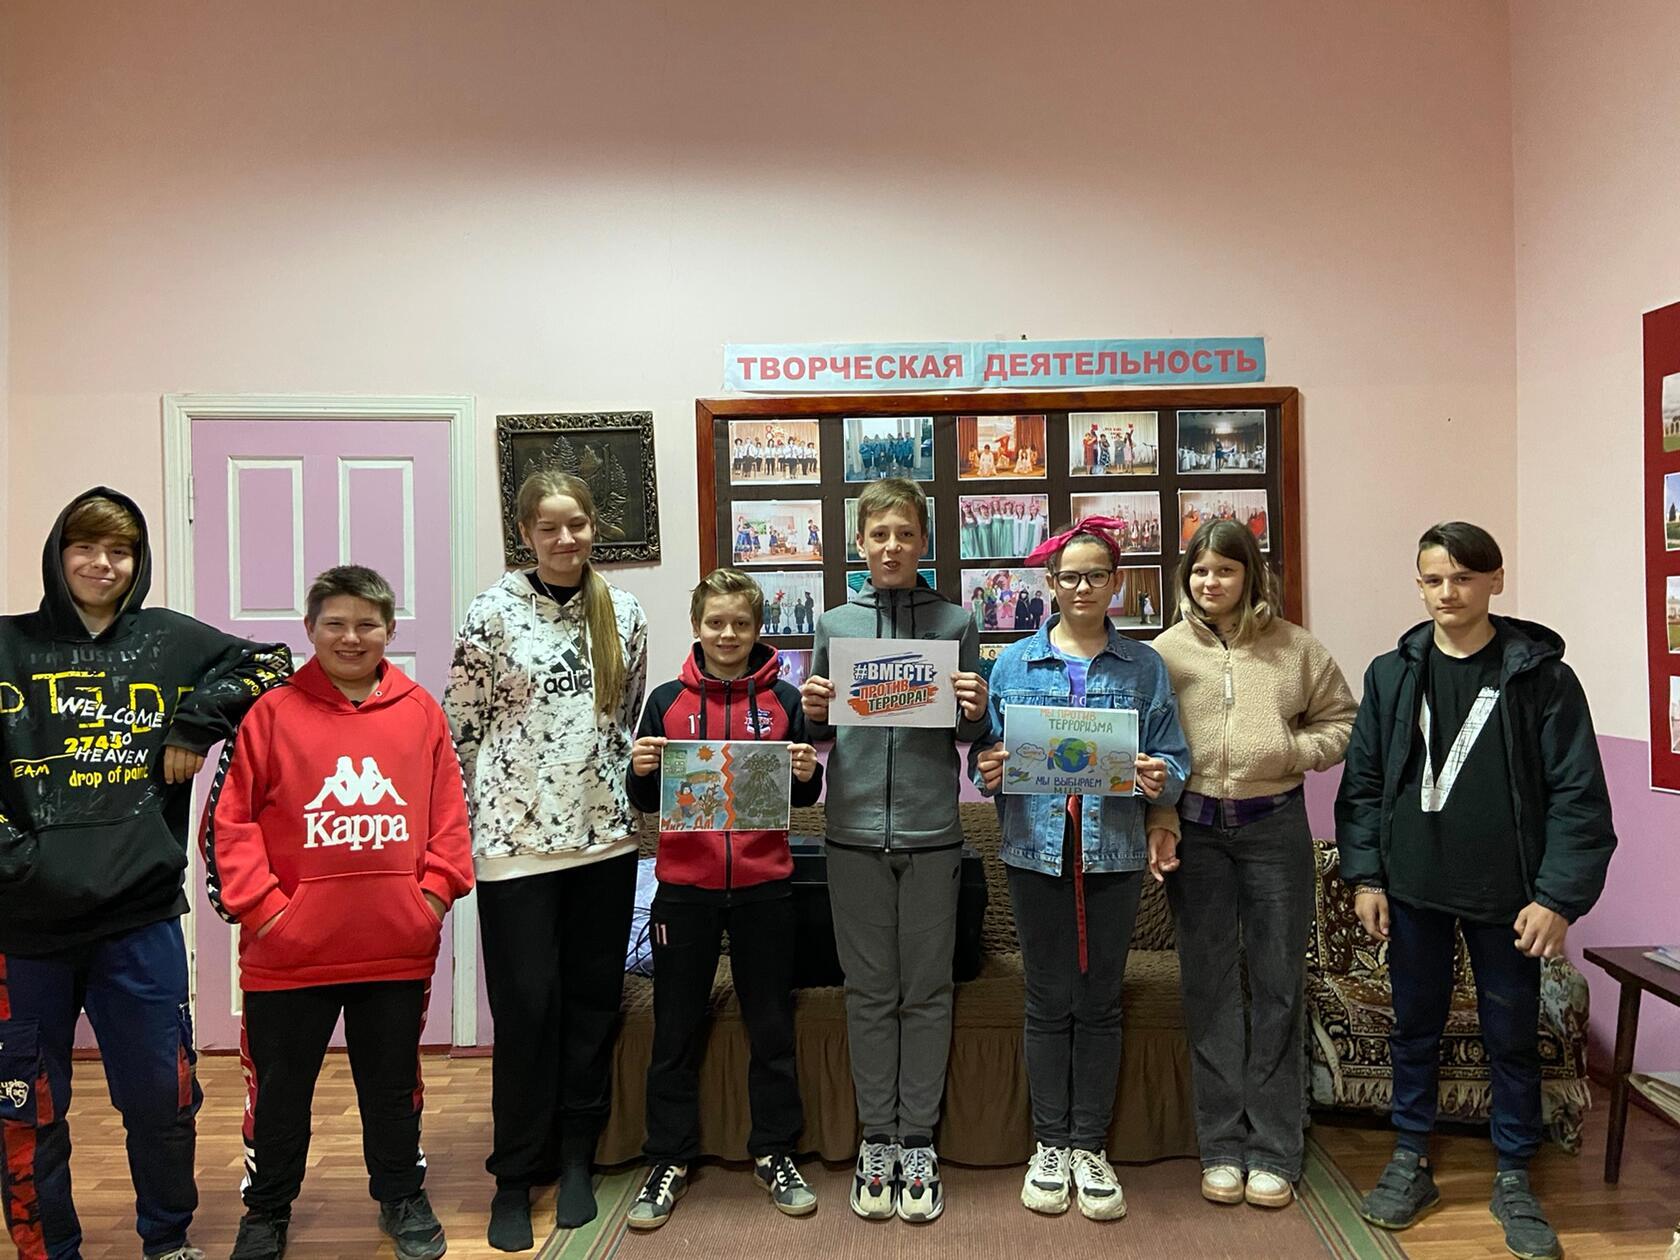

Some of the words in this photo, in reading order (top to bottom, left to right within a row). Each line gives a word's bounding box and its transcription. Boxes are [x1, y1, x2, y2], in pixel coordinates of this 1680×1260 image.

[737, 354, 964, 381] ТВОРЧЕСКАЯ
[983, 349, 1258, 382] ДЕЯТЕЛЬНОСТЬ
[854, 663, 934, 682] #ВМЕСТЕ
[861, 680, 909, 700] ПРОТИВ
[868, 689, 928, 712] ТЕРРОРА!
[57, 696, 165, 729] WELCOME
[1057, 709, 1097, 720] ПРОТИВ
[688, 714, 702, 735] 1
[1048, 718, 1113, 733] ТЕРРОРИЗМА
[109, 730, 132, 746] TO
[75, 746, 149, 764] HEAVEN
[69, 770, 102, 788] drop
[108, 765, 122, 784] of
[1035, 776, 1050, 786] МЫ
[1054, 776, 1102, 788] ВЫБИРАЕМ
[303, 810, 410, 851] Kappa
